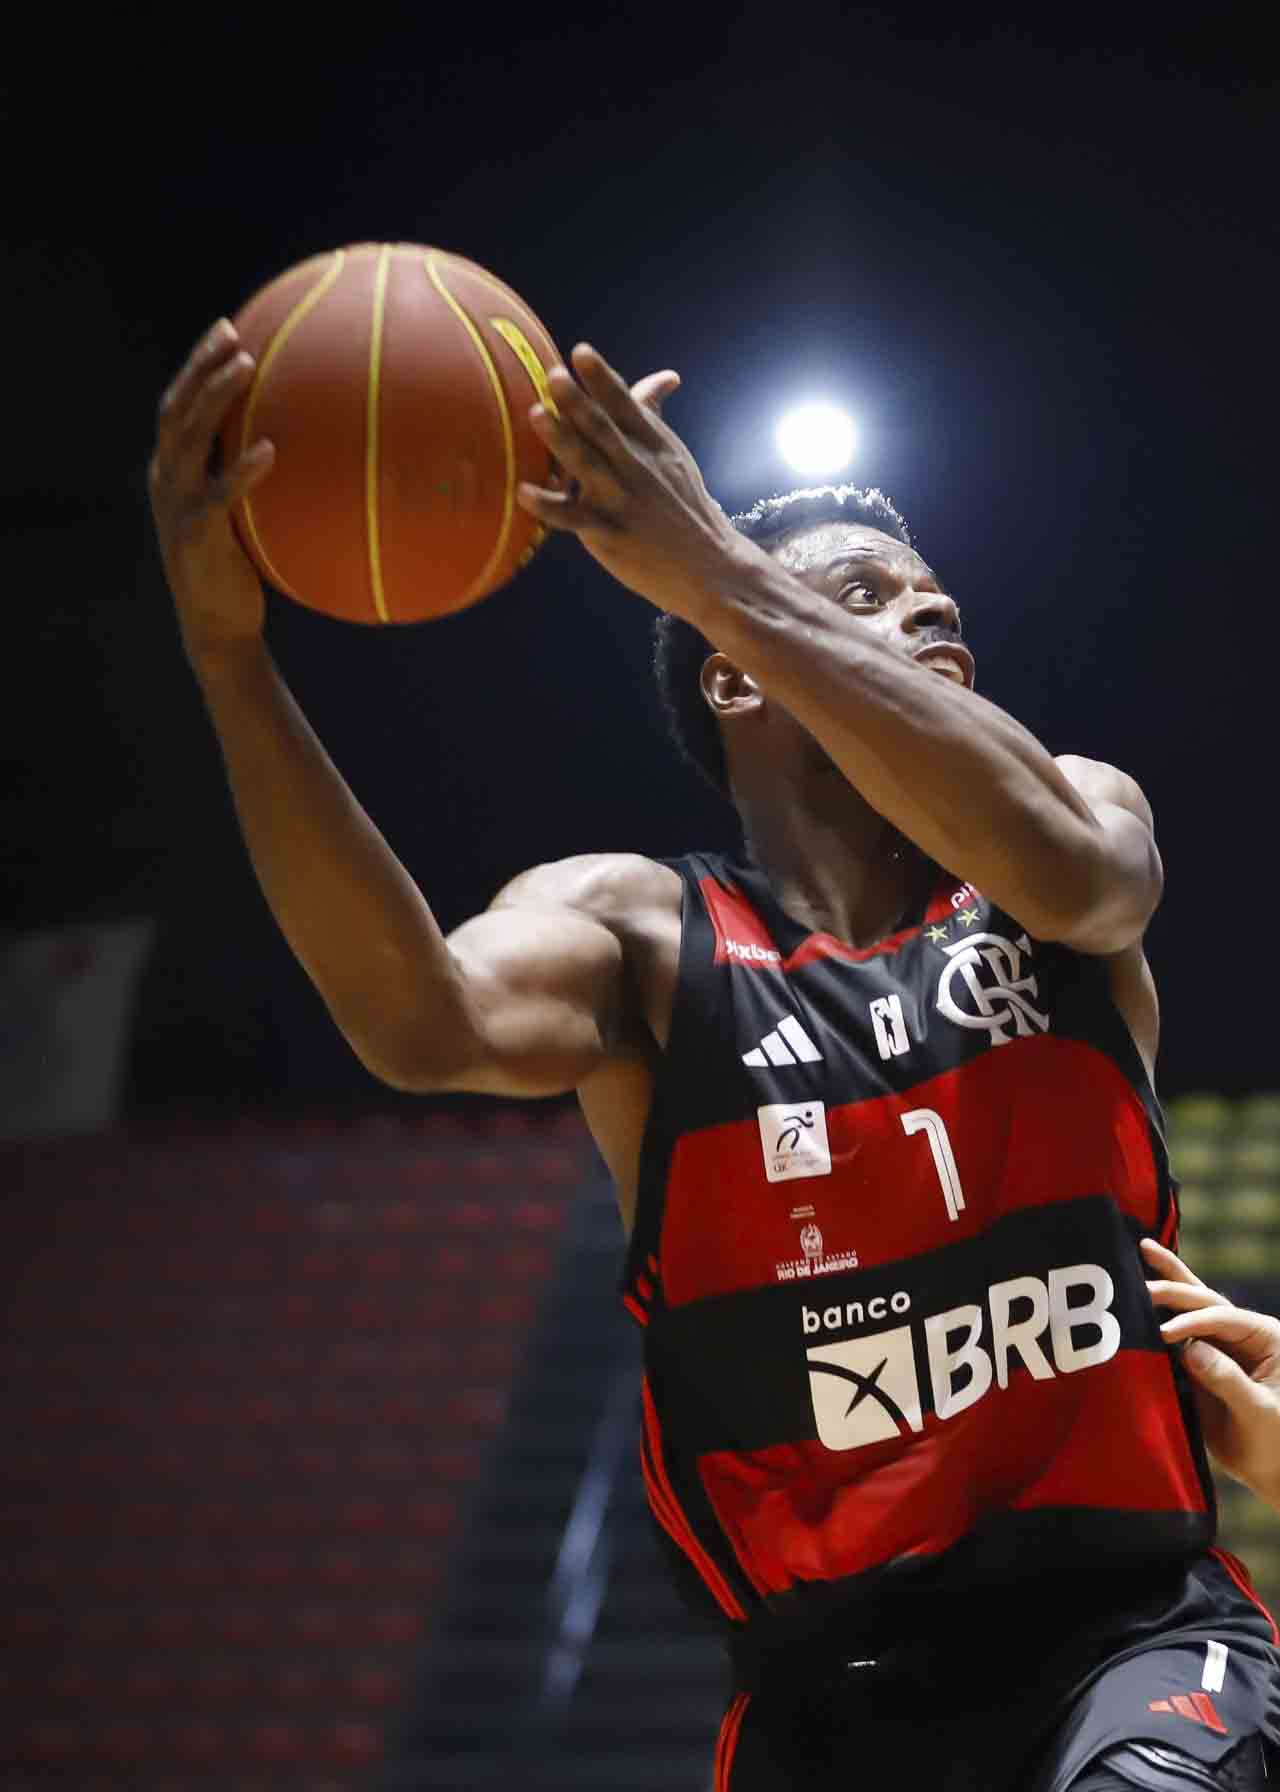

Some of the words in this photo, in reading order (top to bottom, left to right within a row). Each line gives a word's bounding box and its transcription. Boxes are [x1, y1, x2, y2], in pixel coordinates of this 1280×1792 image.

[777, 1268, 796, 1280] RIO
[802, 1290, 911, 1334] banco
[924, 1264, 1121, 1421] BRB
